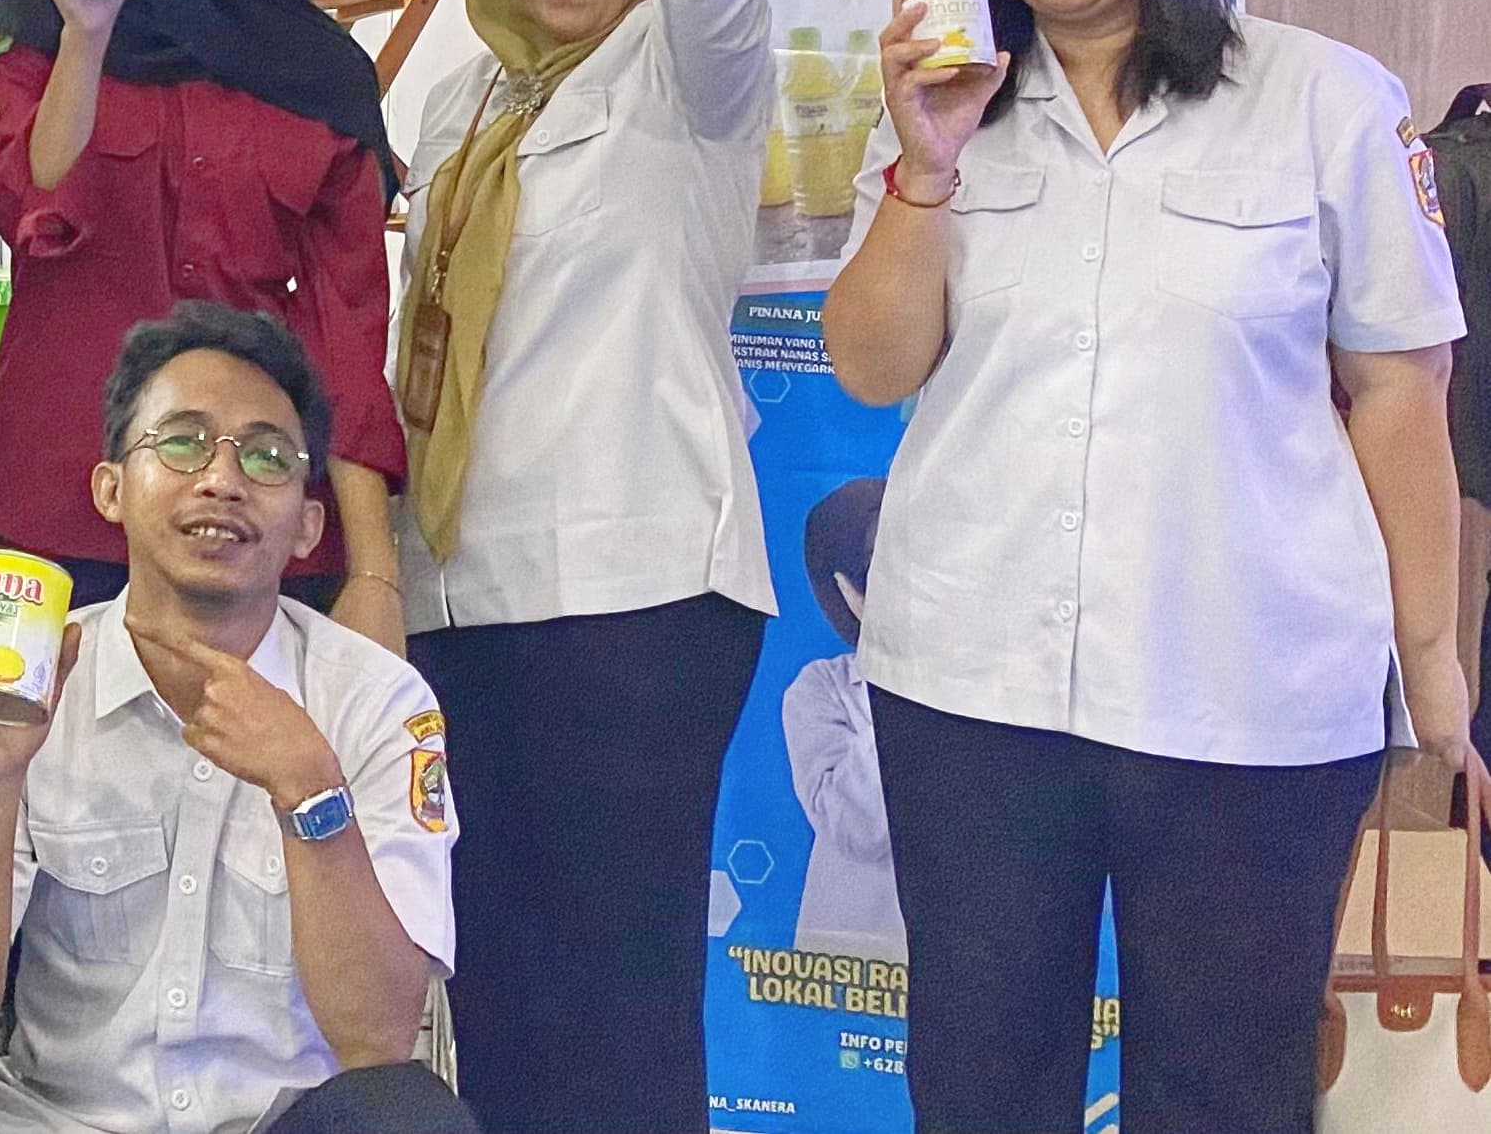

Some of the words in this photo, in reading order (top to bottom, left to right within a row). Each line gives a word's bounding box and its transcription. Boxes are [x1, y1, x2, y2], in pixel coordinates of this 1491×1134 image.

[748, 306, 804, 320] PINANA
[805, 309, 824, 323] JU
[780, 349, 819, 362] NANAS
[749, 976, 838, 1010] LOKAL
[840, 1031, 882, 1052] INFO
[884, 1039, 908, 1054] PE
[863, 1057, 907, 1075] +628
